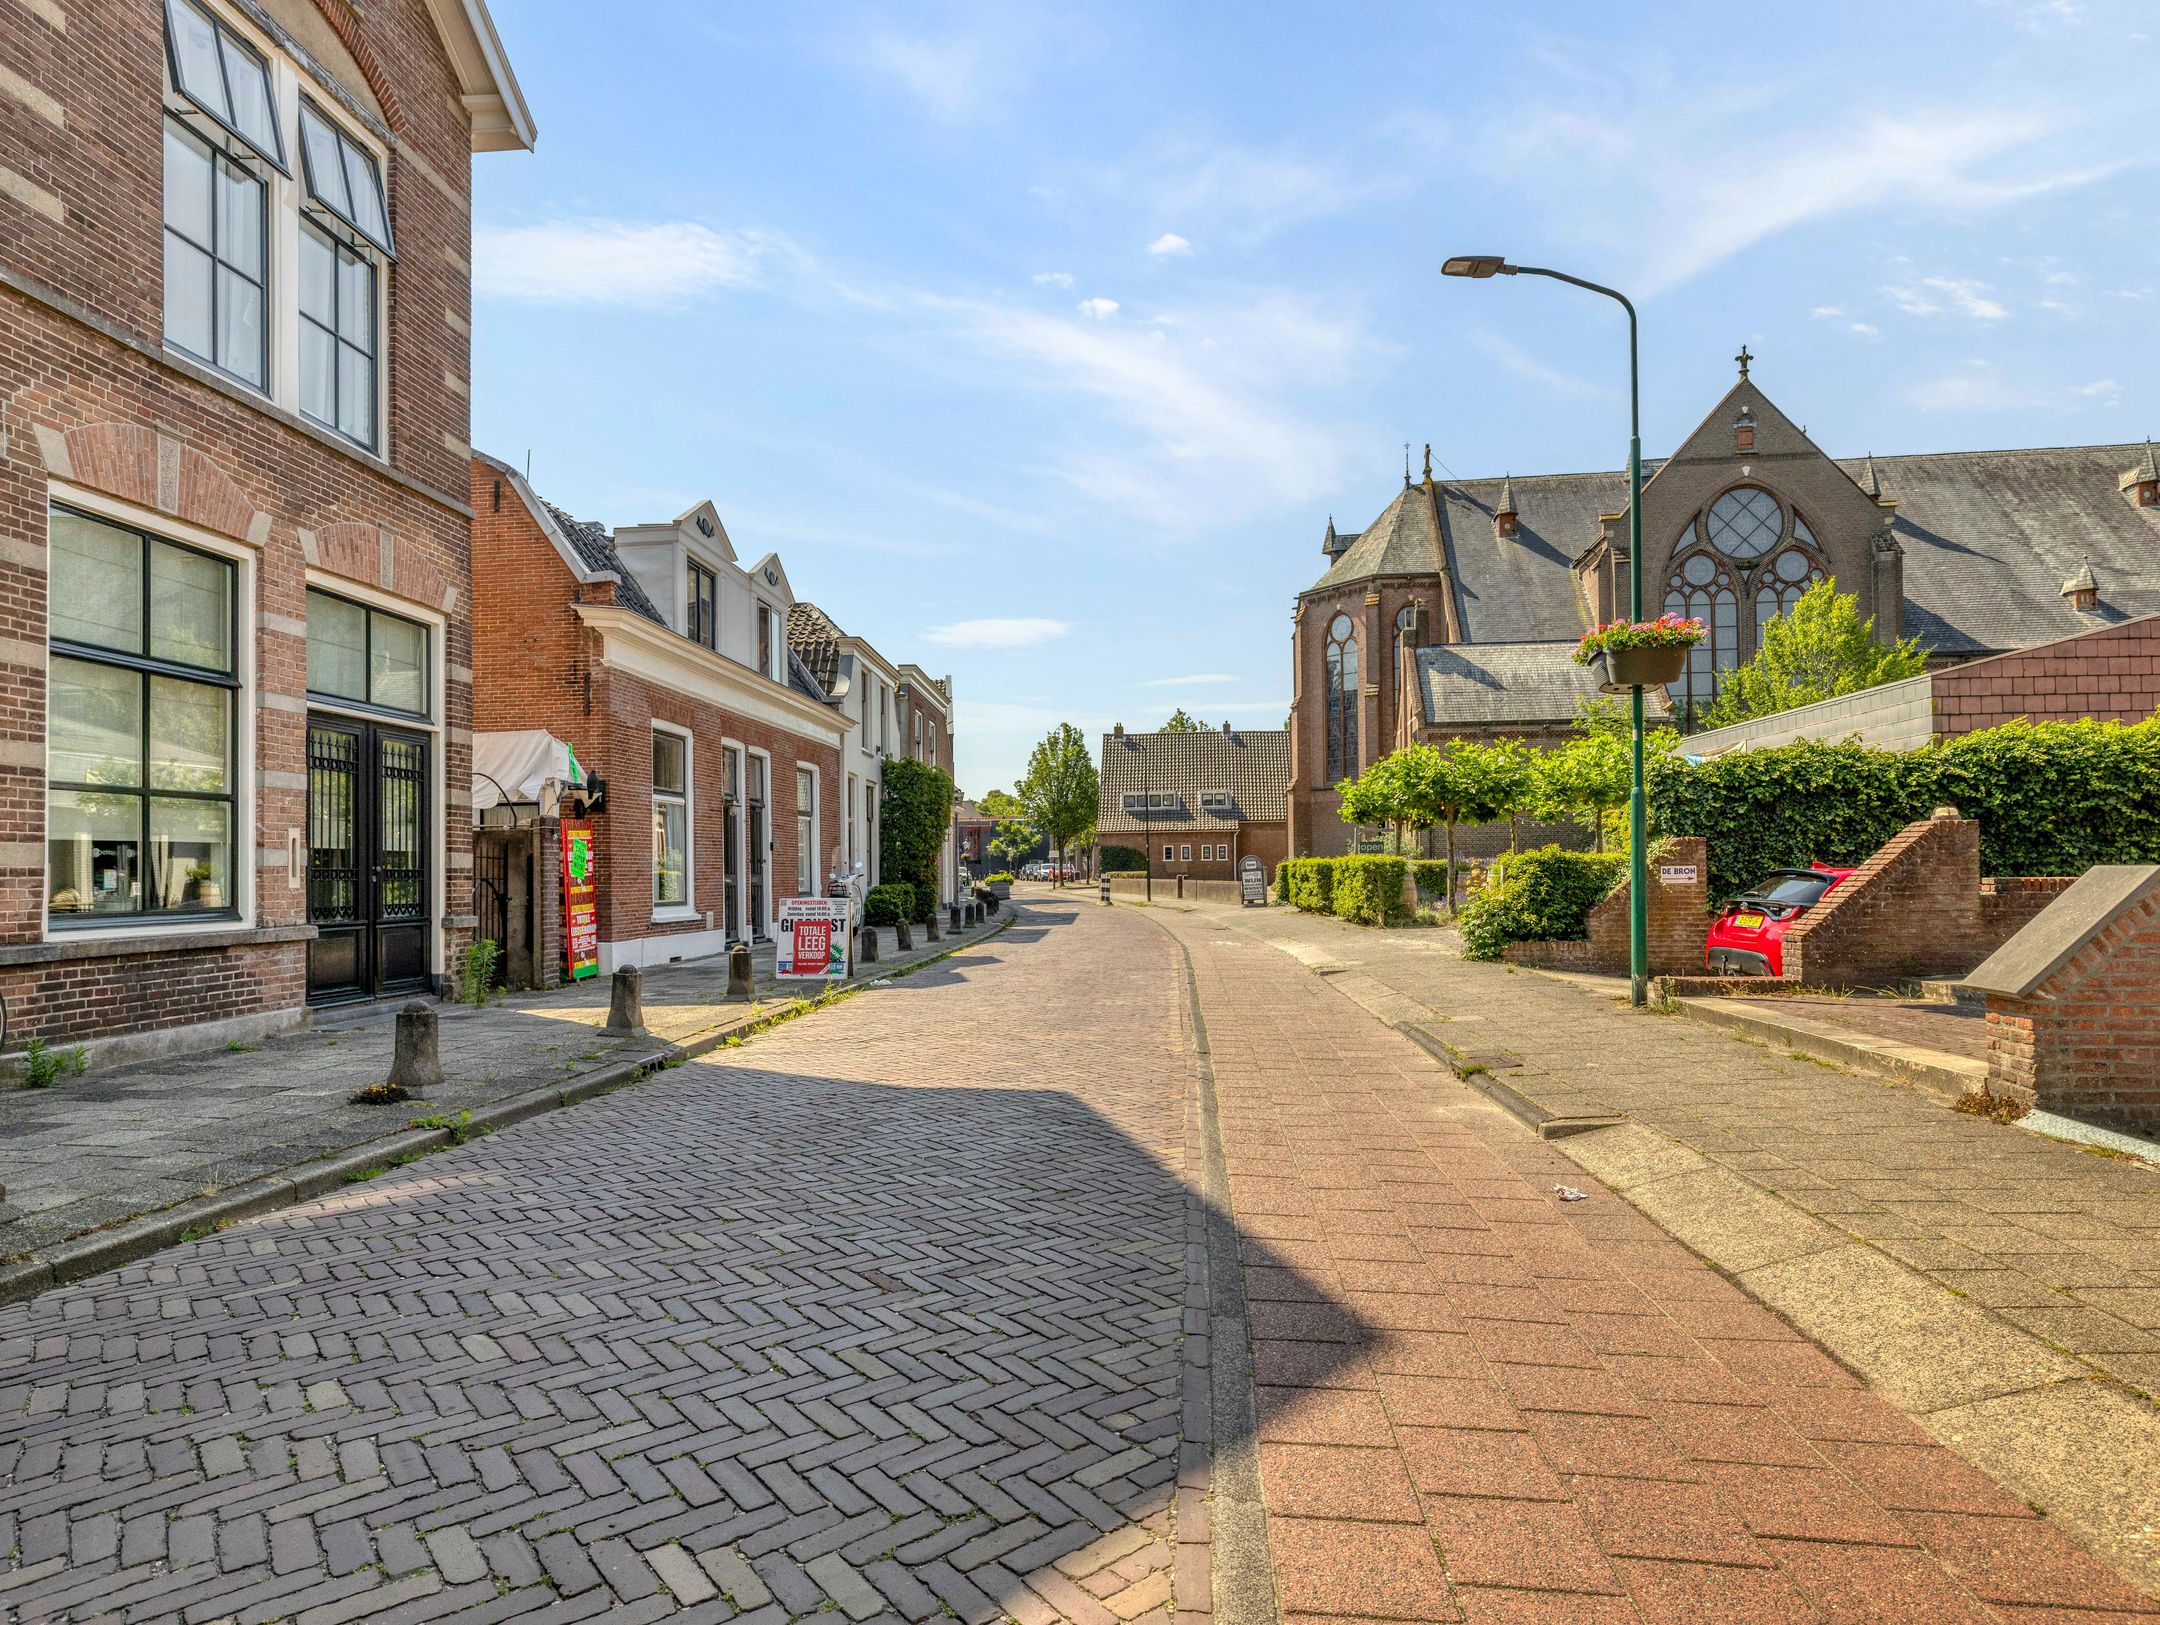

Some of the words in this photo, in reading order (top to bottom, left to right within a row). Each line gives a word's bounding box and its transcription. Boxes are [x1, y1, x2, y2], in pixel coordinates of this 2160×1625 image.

[781, 918, 846, 932] GLST
[799, 925, 826, 935] TOTALE
[798, 936, 826, 951] LEEG
[798, 951, 825, 960] VERKOOP
